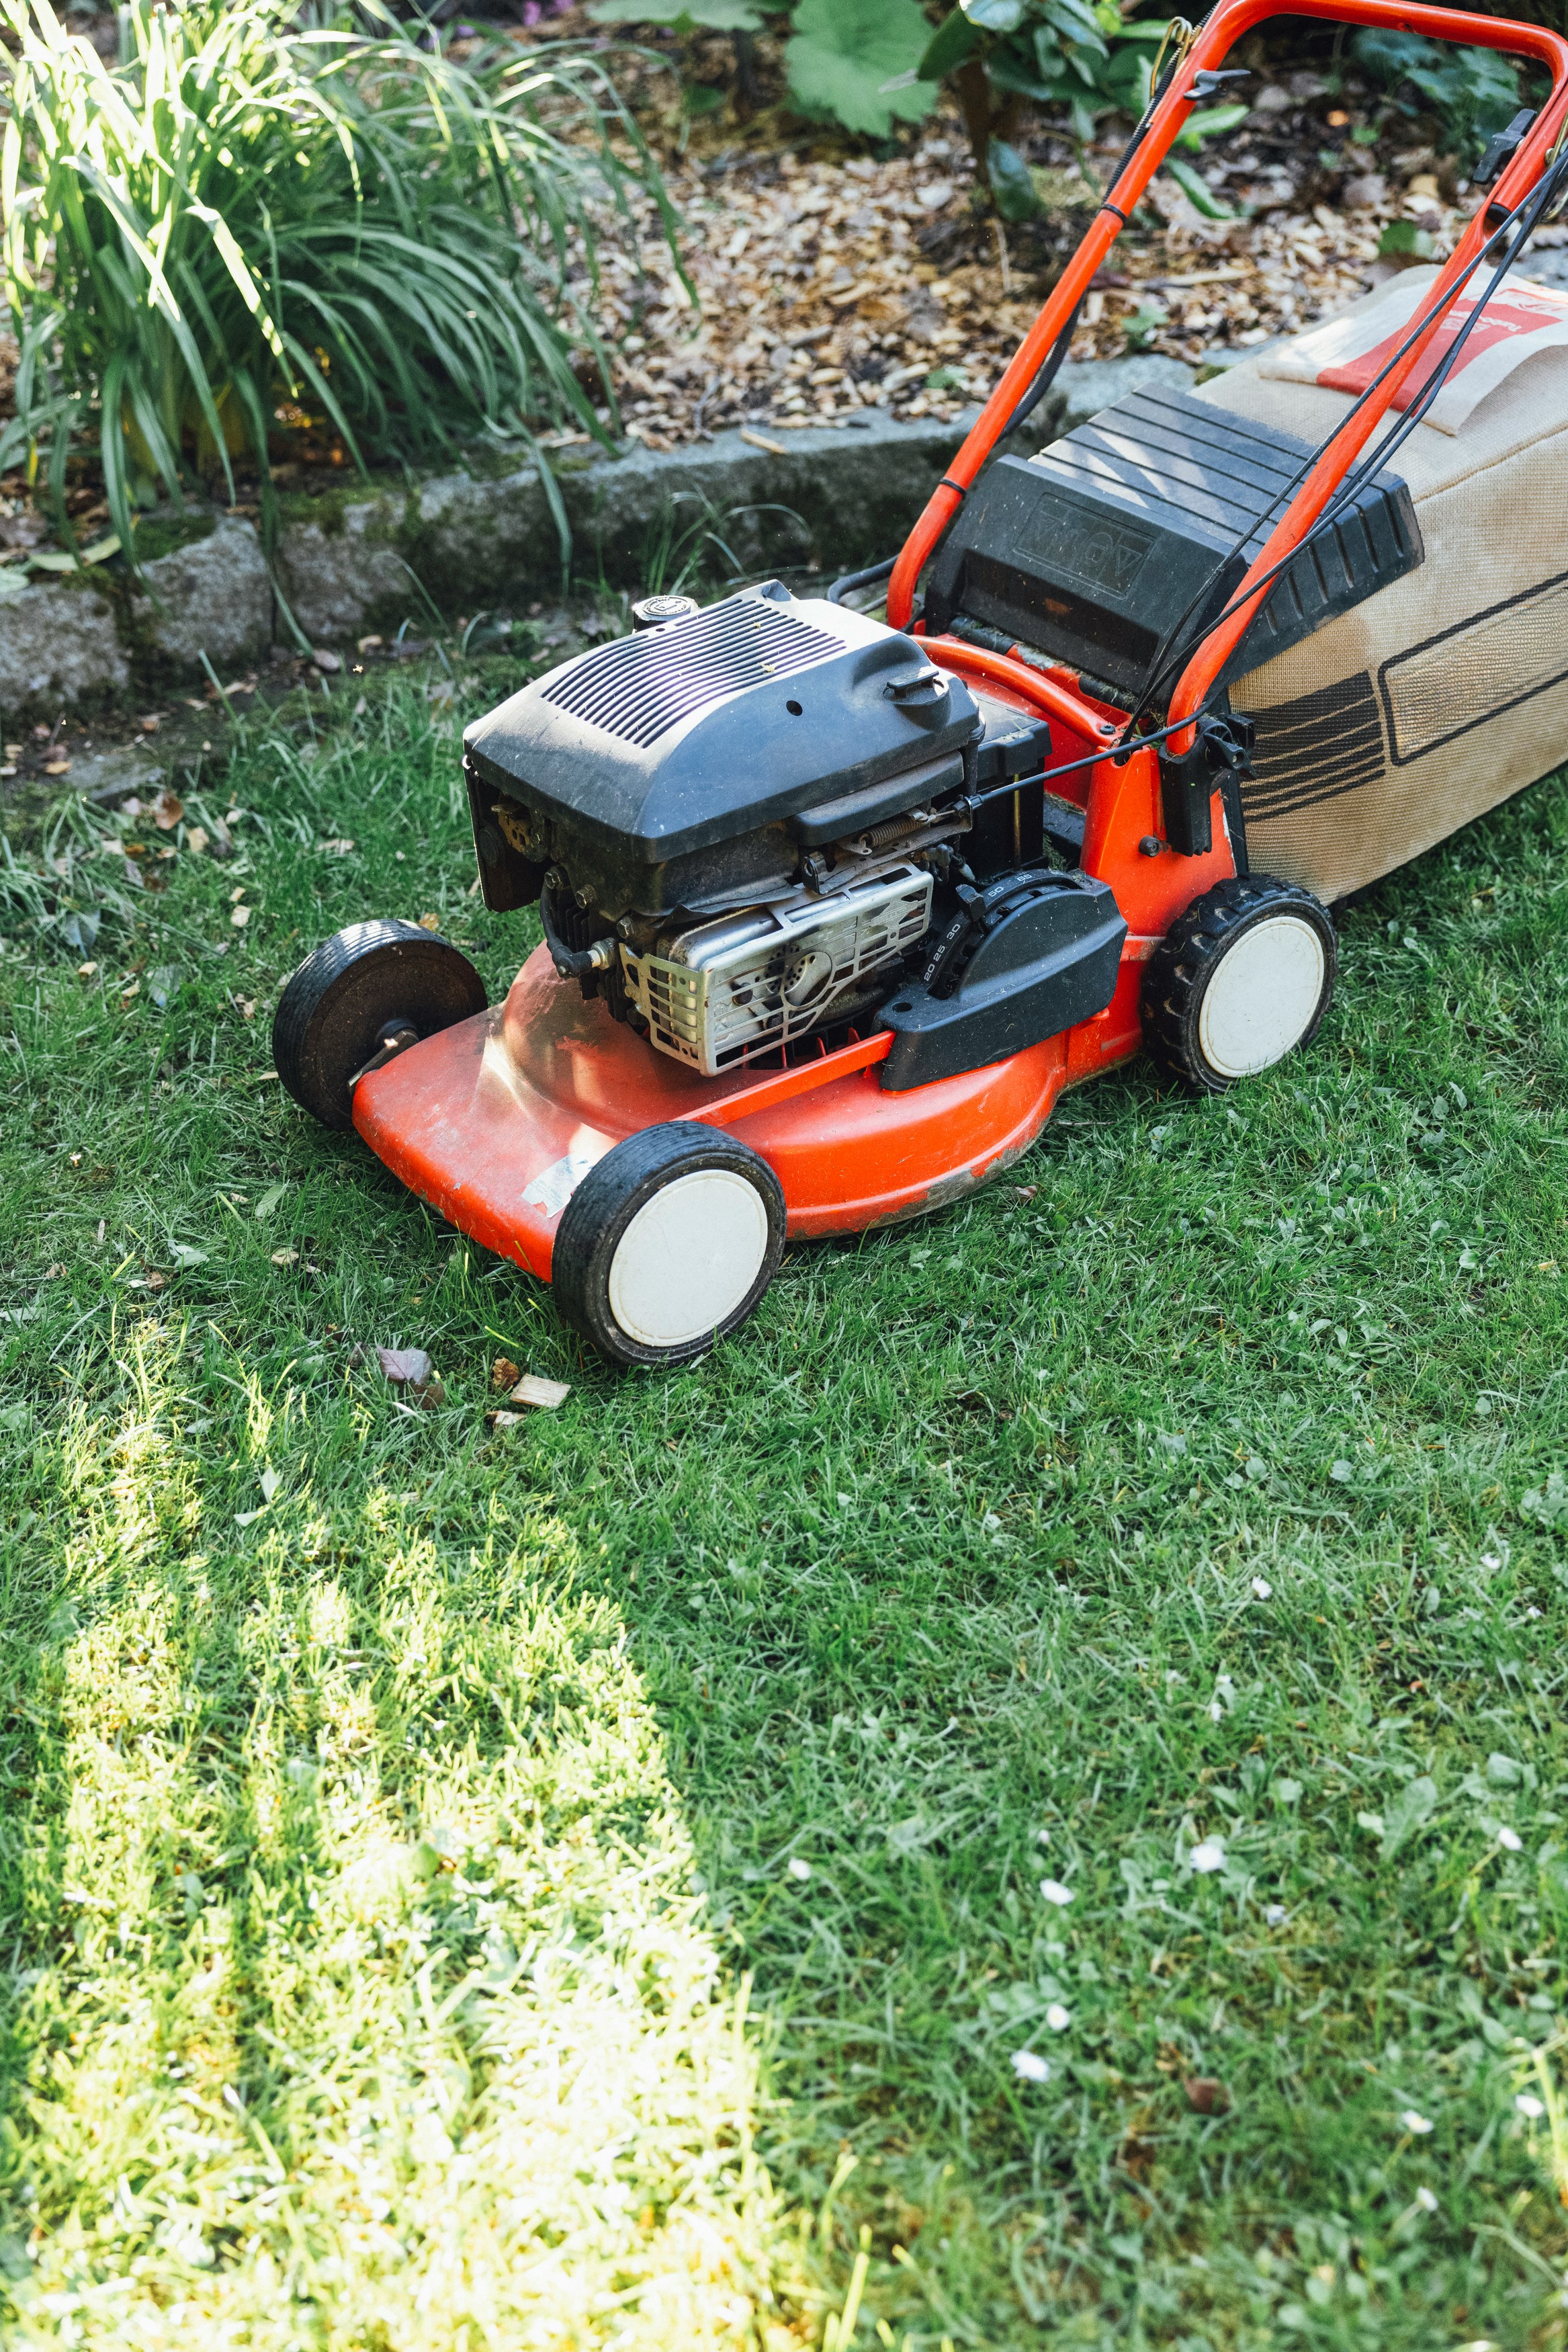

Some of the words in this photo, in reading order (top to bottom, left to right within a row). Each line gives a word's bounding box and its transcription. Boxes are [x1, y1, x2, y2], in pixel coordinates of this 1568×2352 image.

[924, 963, 935, 981] 20
[932, 944, 946, 962] 25
[946, 923, 961, 940] 30
[988, 886, 1004, 897] 50
[1016, 874, 1033, 882] 65
